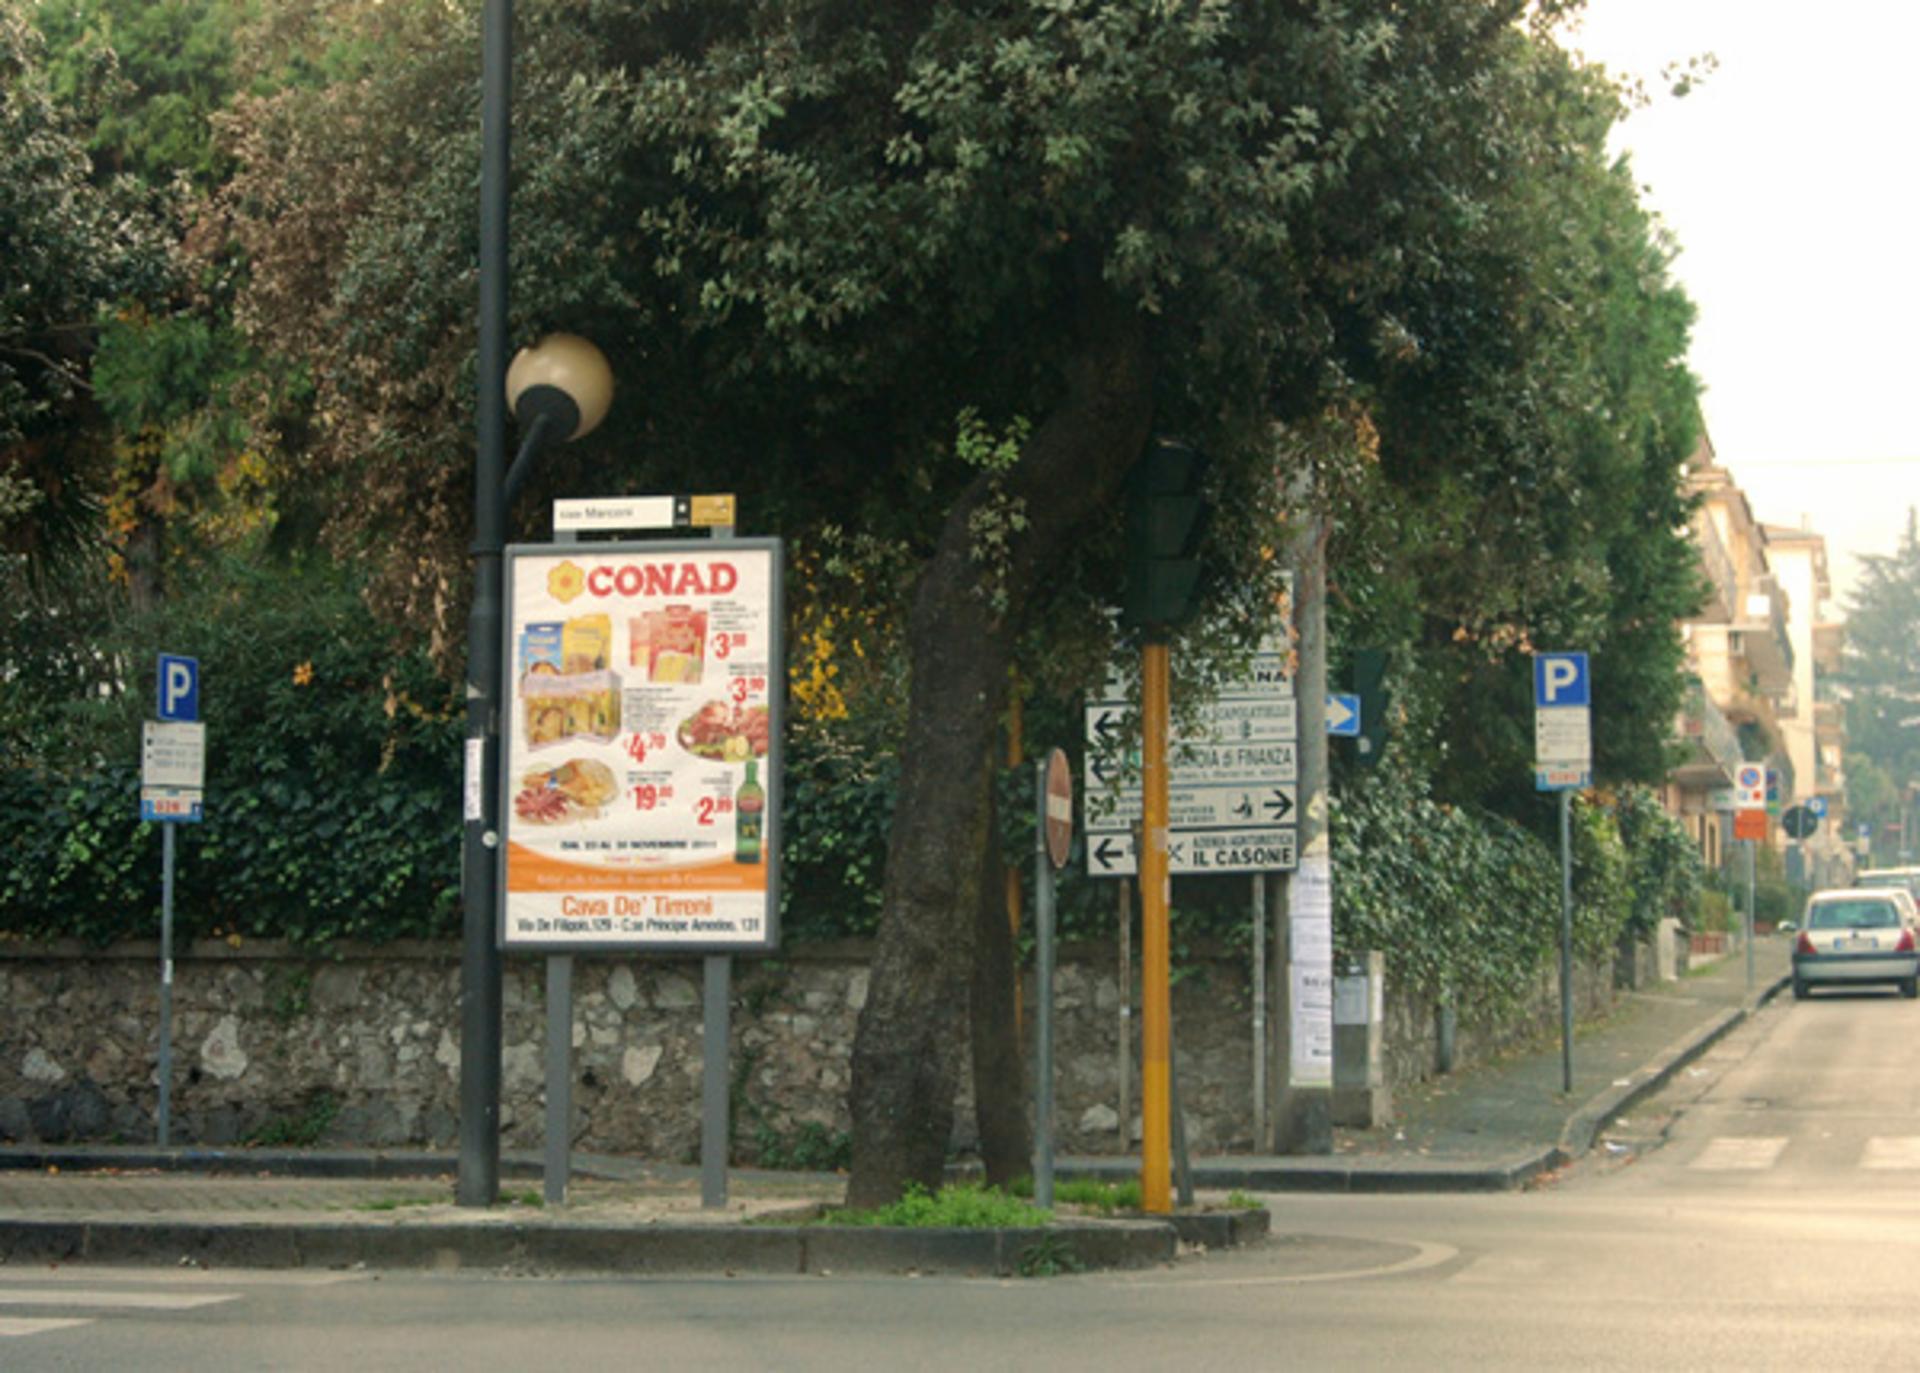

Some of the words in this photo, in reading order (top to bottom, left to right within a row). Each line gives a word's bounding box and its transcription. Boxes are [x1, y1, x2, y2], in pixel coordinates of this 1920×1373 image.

[587, 562, 738, 597] CONAD
[166, 661, 192, 714] P
[1545, 659, 1579, 702] P
[1237, 744, 1292, 767] FINANZA
[1193, 849, 1209, 867] IL
[1215, 846, 1291, 866] CASONE
